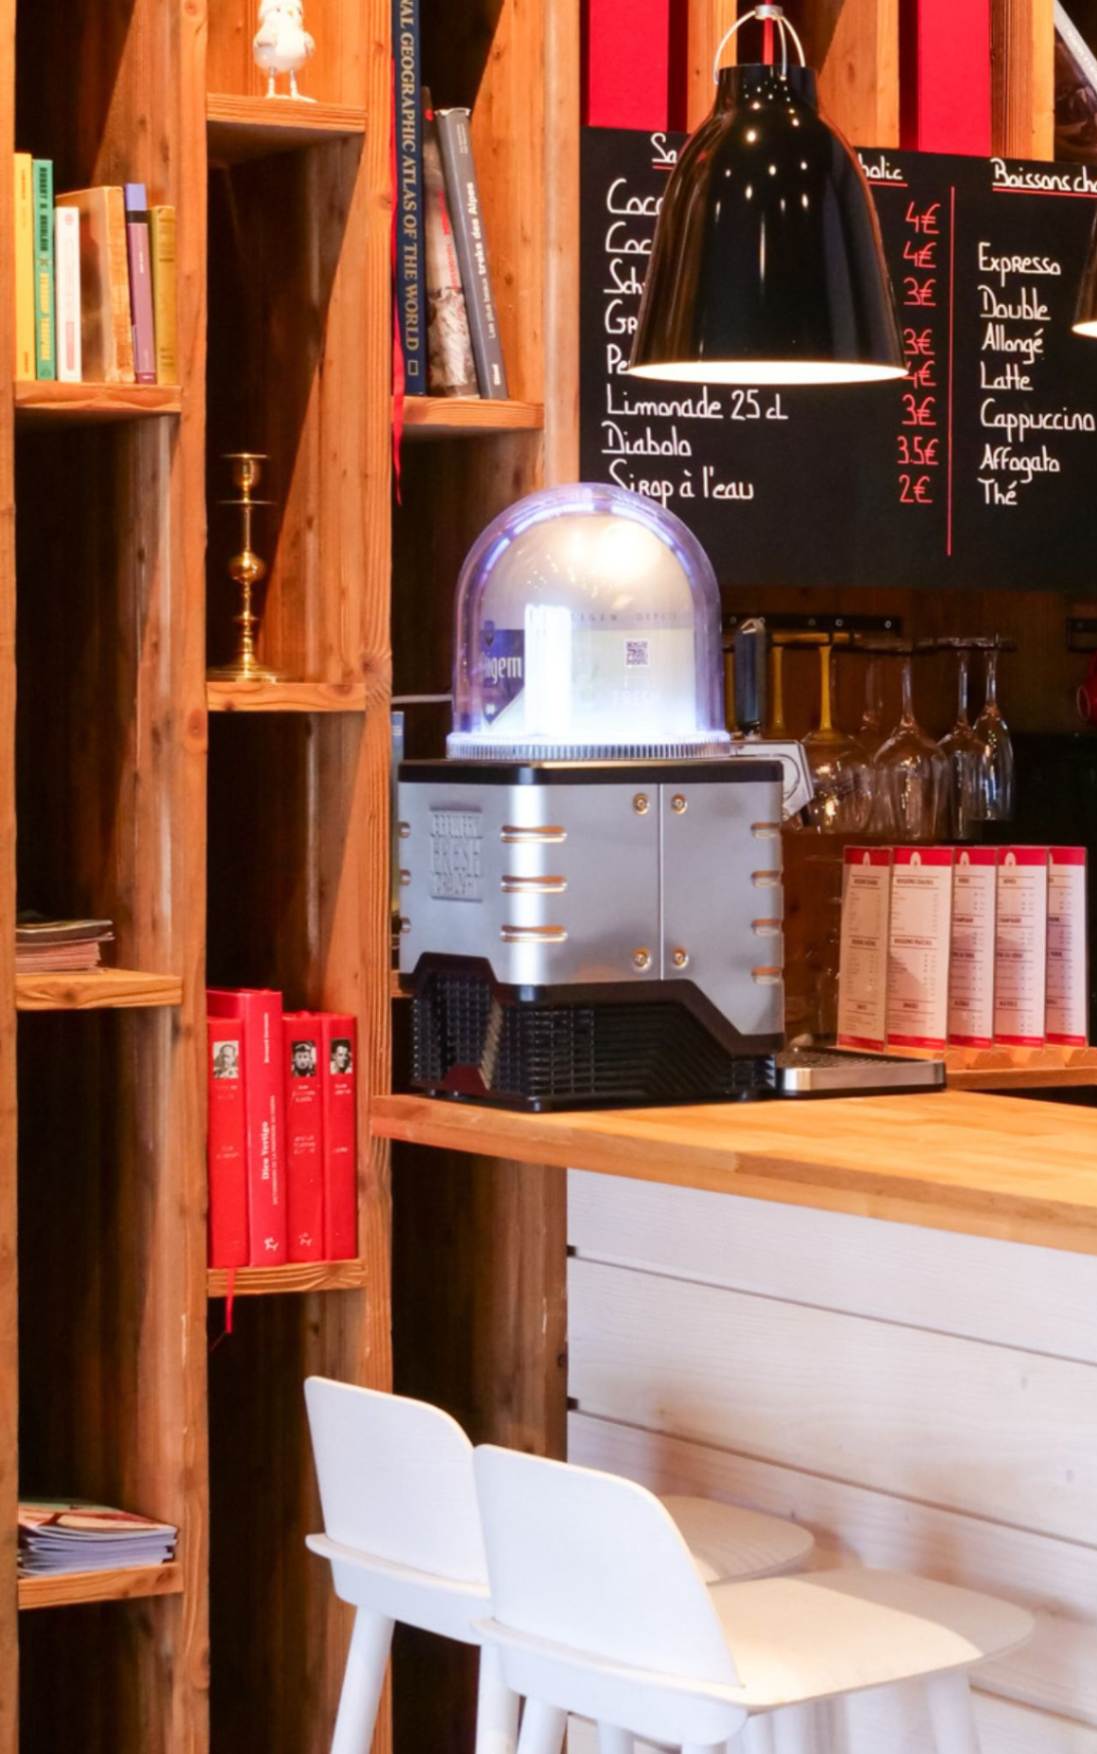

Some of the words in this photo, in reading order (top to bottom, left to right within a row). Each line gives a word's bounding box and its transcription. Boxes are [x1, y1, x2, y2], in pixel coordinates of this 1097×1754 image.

[400, 32, 416, 153] GEOGRAPHIC
[402, 155, 417, 212] ATLAS
[990, 157, 1072, 192] Boissons
[465, 182, 479, 215] Alpes
[403, 214, 418, 239] OF
[470, 217, 482, 240] des
[905, 201, 941, 234] 4€
[404, 242, 418, 281] THE
[902, 241, 936, 268] 4€
[978, 241, 1061, 288] Expresso
[903, 277, 936, 306] 3€
[977, 284, 1051, 321] Double
[405, 283, 420, 352] WORLD
[903, 328, 936, 357] 3€
[981, 321, 1044, 365] Allongé
[980, 361, 1034, 391] Latte
[606, 383, 724, 419] Limonade
[902, 394, 937, 425] 3€
[980, 397, 1096, 443] Cappuccino
[601, 420, 693, 456] Diabolo
[979, 443, 1061, 484] Affogato
[679, 469, 697, 498] à
[703, 465, 754, 500] l'eau
[899, 474, 934, 503] 2€
[977, 477, 1018, 505] Thé
